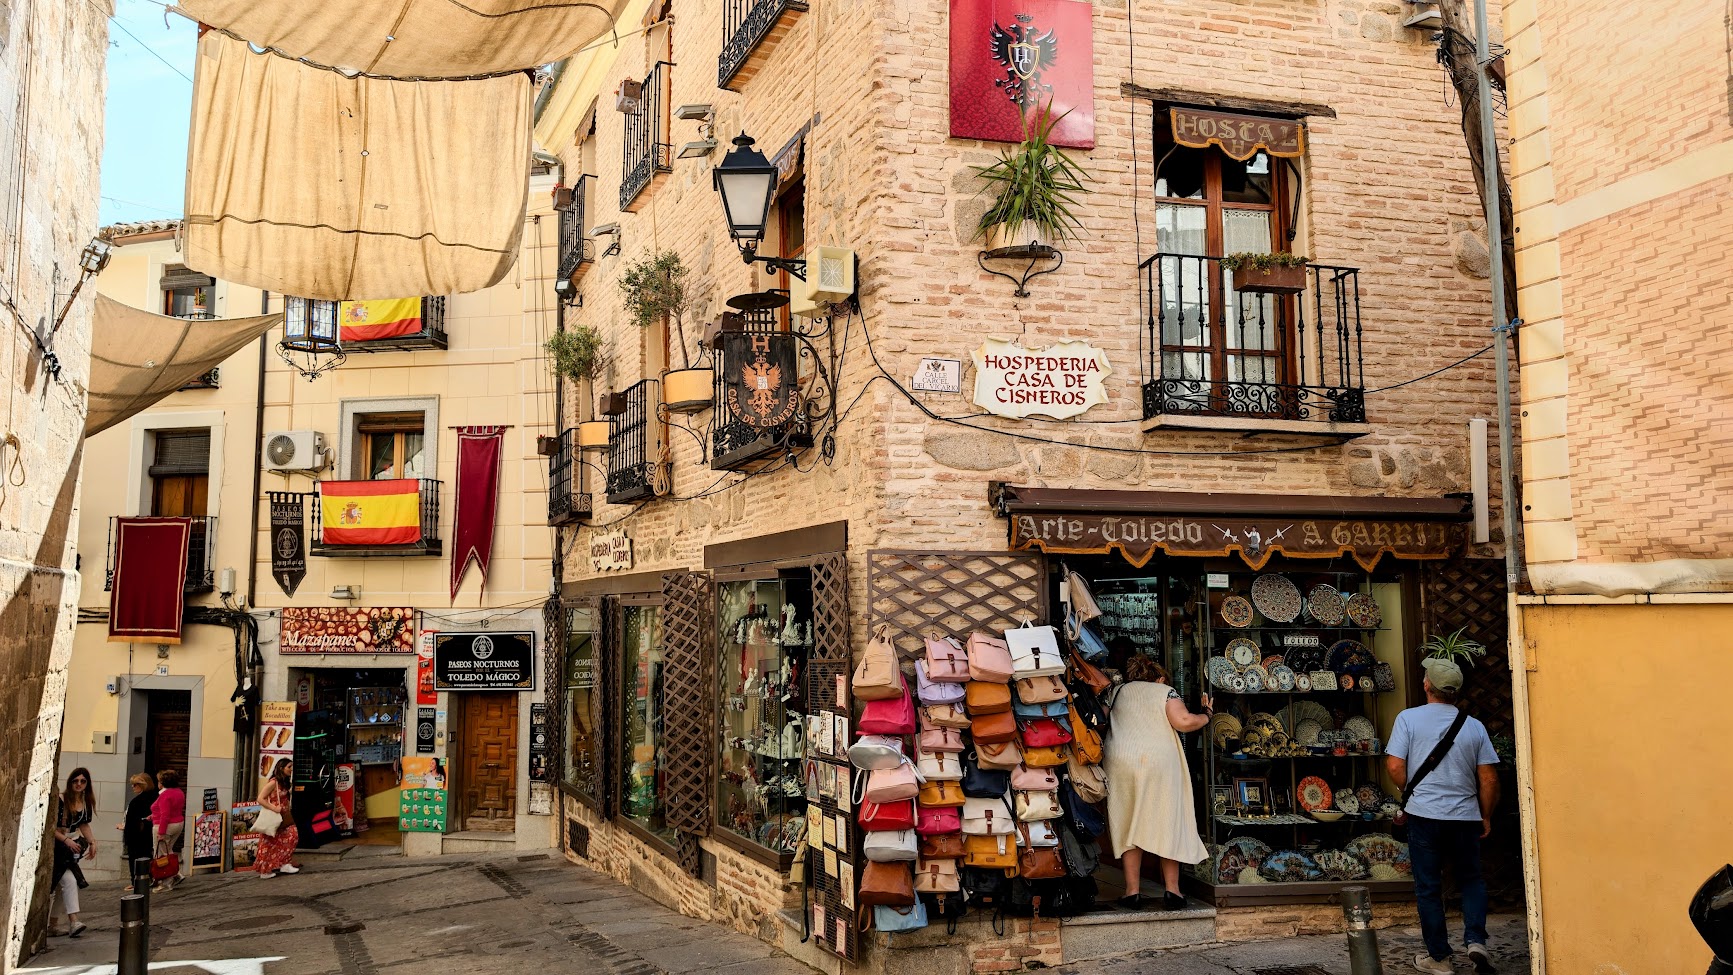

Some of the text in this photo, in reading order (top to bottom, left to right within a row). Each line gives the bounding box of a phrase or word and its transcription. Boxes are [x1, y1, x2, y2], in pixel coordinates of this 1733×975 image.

[1177, 114, 1297, 147] HOSTAL
[1231, 139, 1244, 154] H
[751, 335, 770, 352] H
[985, 355, 1100, 372] HOSPEDERIA
[1004, 371, 1088, 388] CASA DE
[995, 387, 1086, 405] CISNEROS
[728, 388, 798, 426] CASA DE CISNEROS
[480, 620, 489, 628] 12
[282, 630, 358, 651] Mazapanes
[473, 660, 519, 668] NOCTURNOS
[447, 672, 520, 681] TOLEDO MÁGICO
